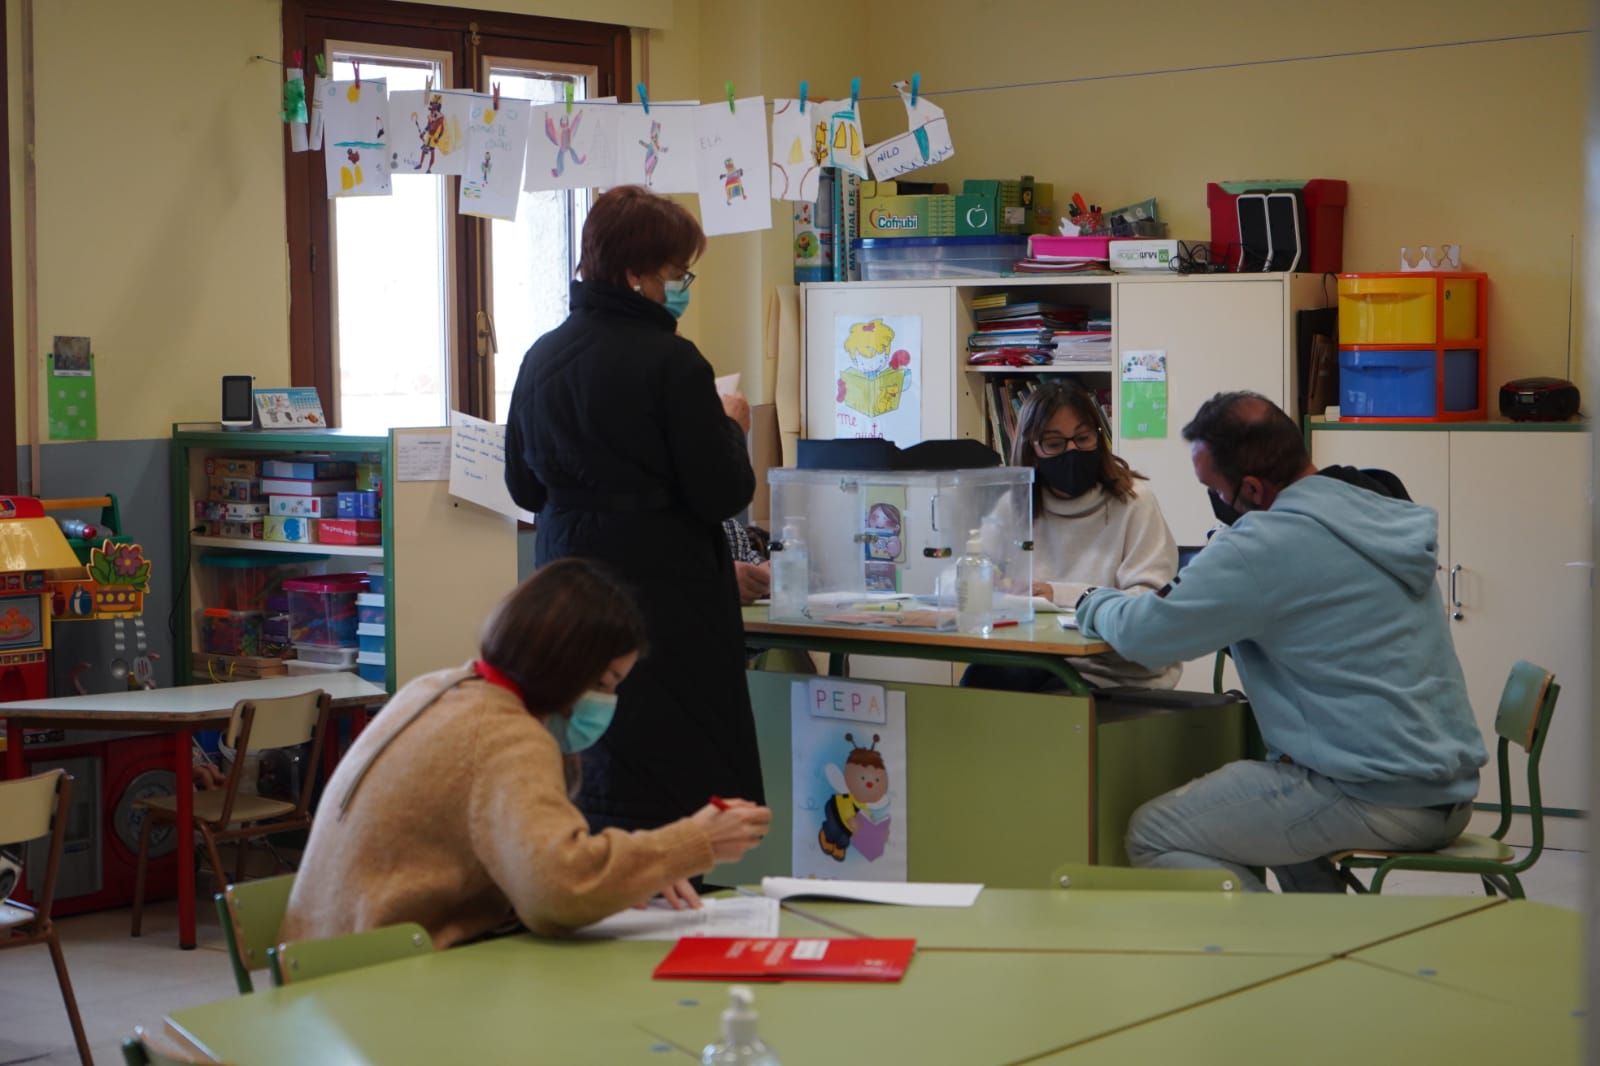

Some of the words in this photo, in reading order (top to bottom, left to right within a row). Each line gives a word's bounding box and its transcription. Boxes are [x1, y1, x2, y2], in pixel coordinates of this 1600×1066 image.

[876, 146, 900, 163] NILO
[848, 192, 856, 207] DE
[878, 216, 917, 229] Cofrubi
[816, 689, 880, 713] PEPA
